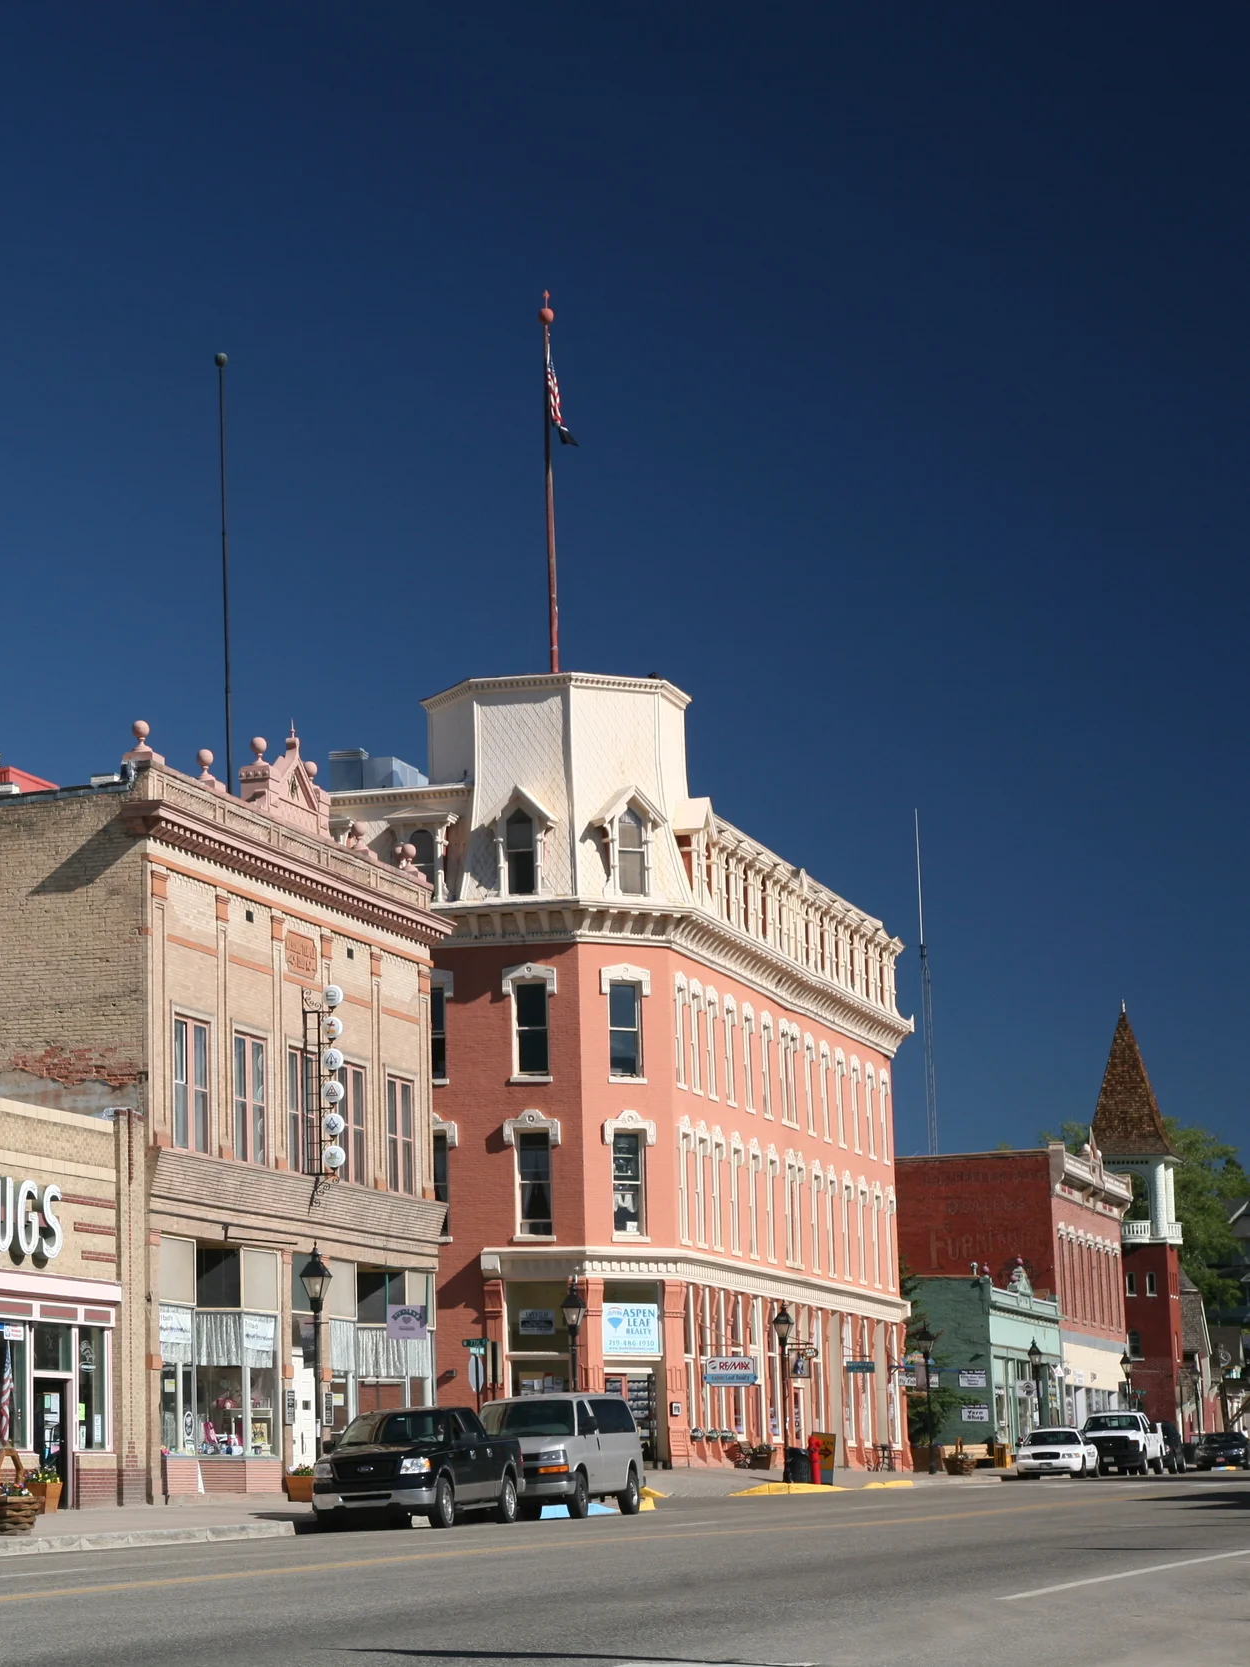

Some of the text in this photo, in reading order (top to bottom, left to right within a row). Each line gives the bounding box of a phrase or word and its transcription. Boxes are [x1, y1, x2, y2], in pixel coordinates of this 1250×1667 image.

[622, 1308, 655, 1318] ASPEN
[627, 1318, 651, 1327] LEAF
[625, 1328, 652, 1336] REALTY
[718, 1361, 751, 1371] RE/MAX
